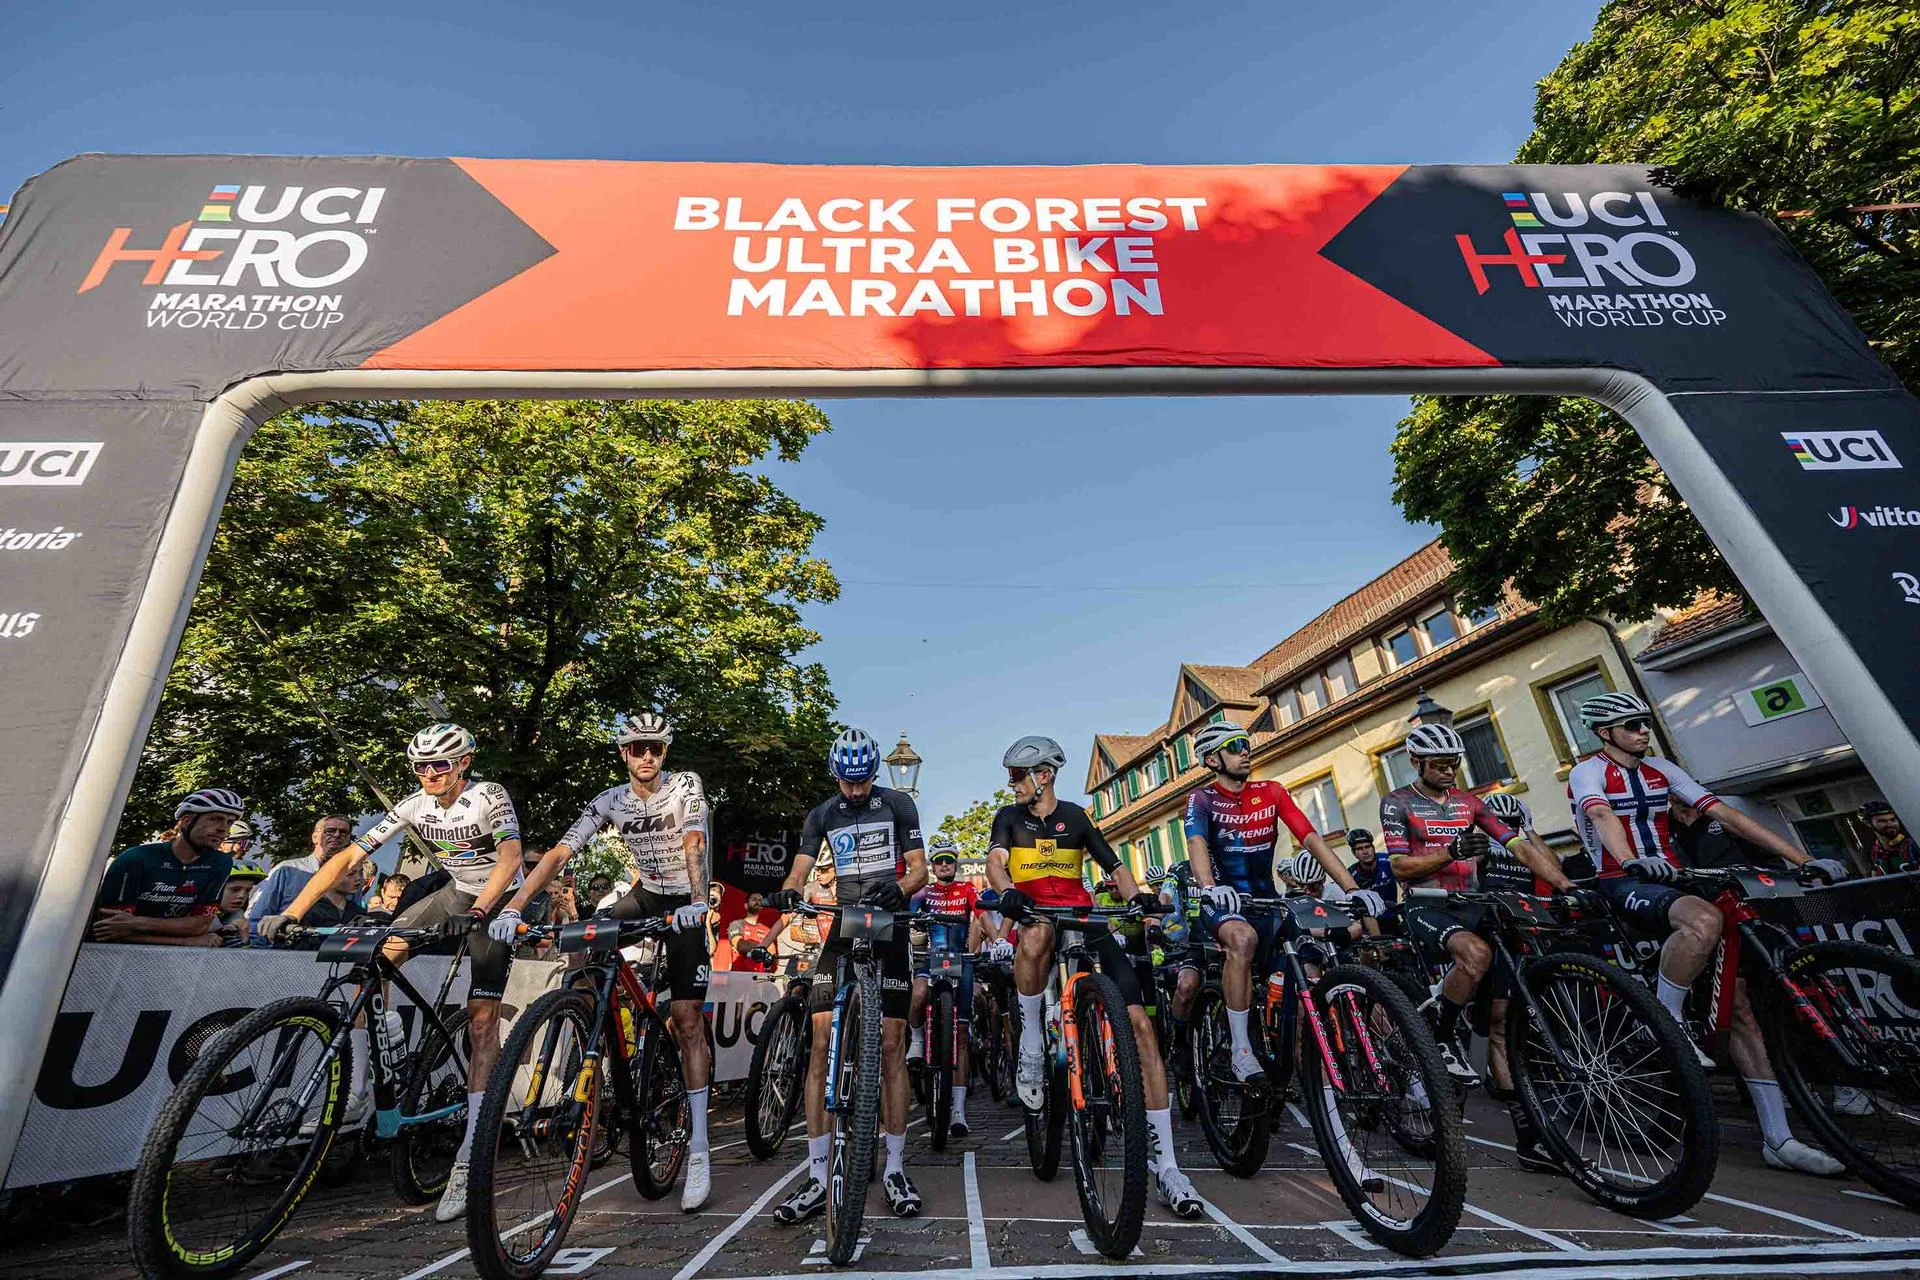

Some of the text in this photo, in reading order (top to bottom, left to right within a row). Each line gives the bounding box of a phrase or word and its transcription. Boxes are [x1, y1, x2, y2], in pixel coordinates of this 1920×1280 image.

[237, 185, 386, 225] UCI
[674, 196, 1208, 231] BLACK FOREST
[1530, 191, 1667, 227] UCI
[76, 219, 368, 294] HERO
[731, 236, 1159, 273] ULTRA BIKE
[1455, 227, 1696, 295] HERO
[150, 292, 341, 311] MARATHON
[726, 278, 1164, 316] MARATHON
[1548, 293, 1713, 311] MARATHON
[146, 310, 345, 330] WORLD CUP
[1555, 309, 1727, 328] WORLD CUP
[1803, 438, 1890, 463] UCI
[622, 812, 677, 835] KTM
[1212, 805, 1276, 824] TORPADO
[418, 823, 482, 841] Klimatiza
[1238, 825, 1274, 839] KENDA
[728, 843, 787, 865] HERO
[744, 864, 784, 872] MARATHON
[1757, 873, 1775, 887] 6
[864, 912, 872, 928] 1
[583, 924, 598, 940] 5
[341, 937, 360, 951] 7
[1790, 954, 1816, 972] XXIS
[372, 993, 393, 1085] ORBEA
[275, 1016, 341, 1126] PRORESS
